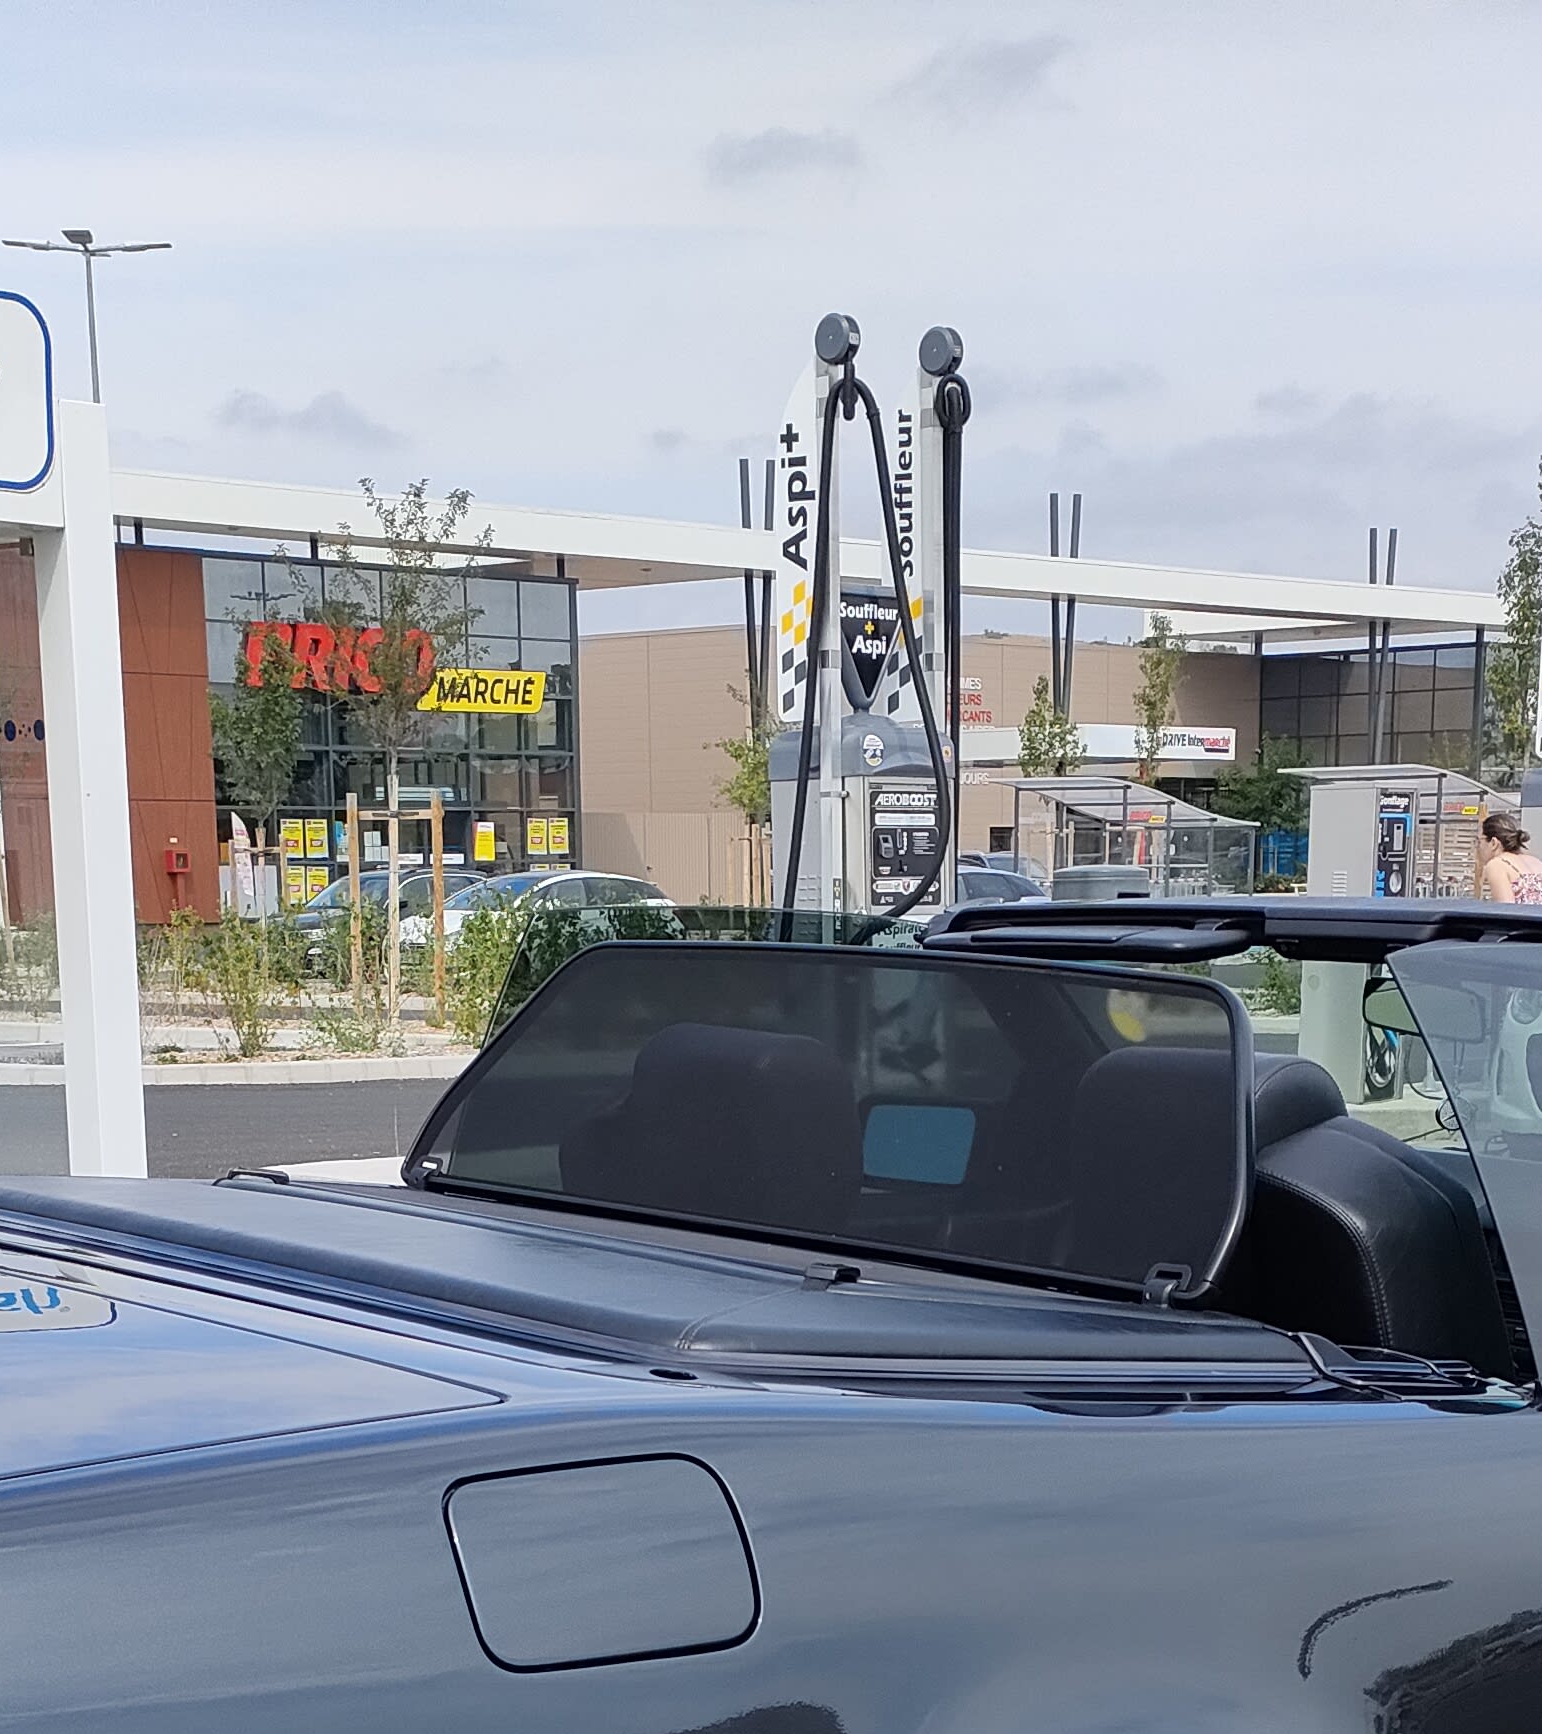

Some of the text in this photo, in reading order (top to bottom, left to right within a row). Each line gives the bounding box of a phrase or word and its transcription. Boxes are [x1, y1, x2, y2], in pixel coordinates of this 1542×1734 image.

[839, 602, 898, 621] Souffleur
[851, 636, 887, 660] Aspi
[436, 676, 534, 705] MARCHÉ
[1162, 732, 1187, 747] DRIVE
[875, 793, 937, 806] AEROBOOST
